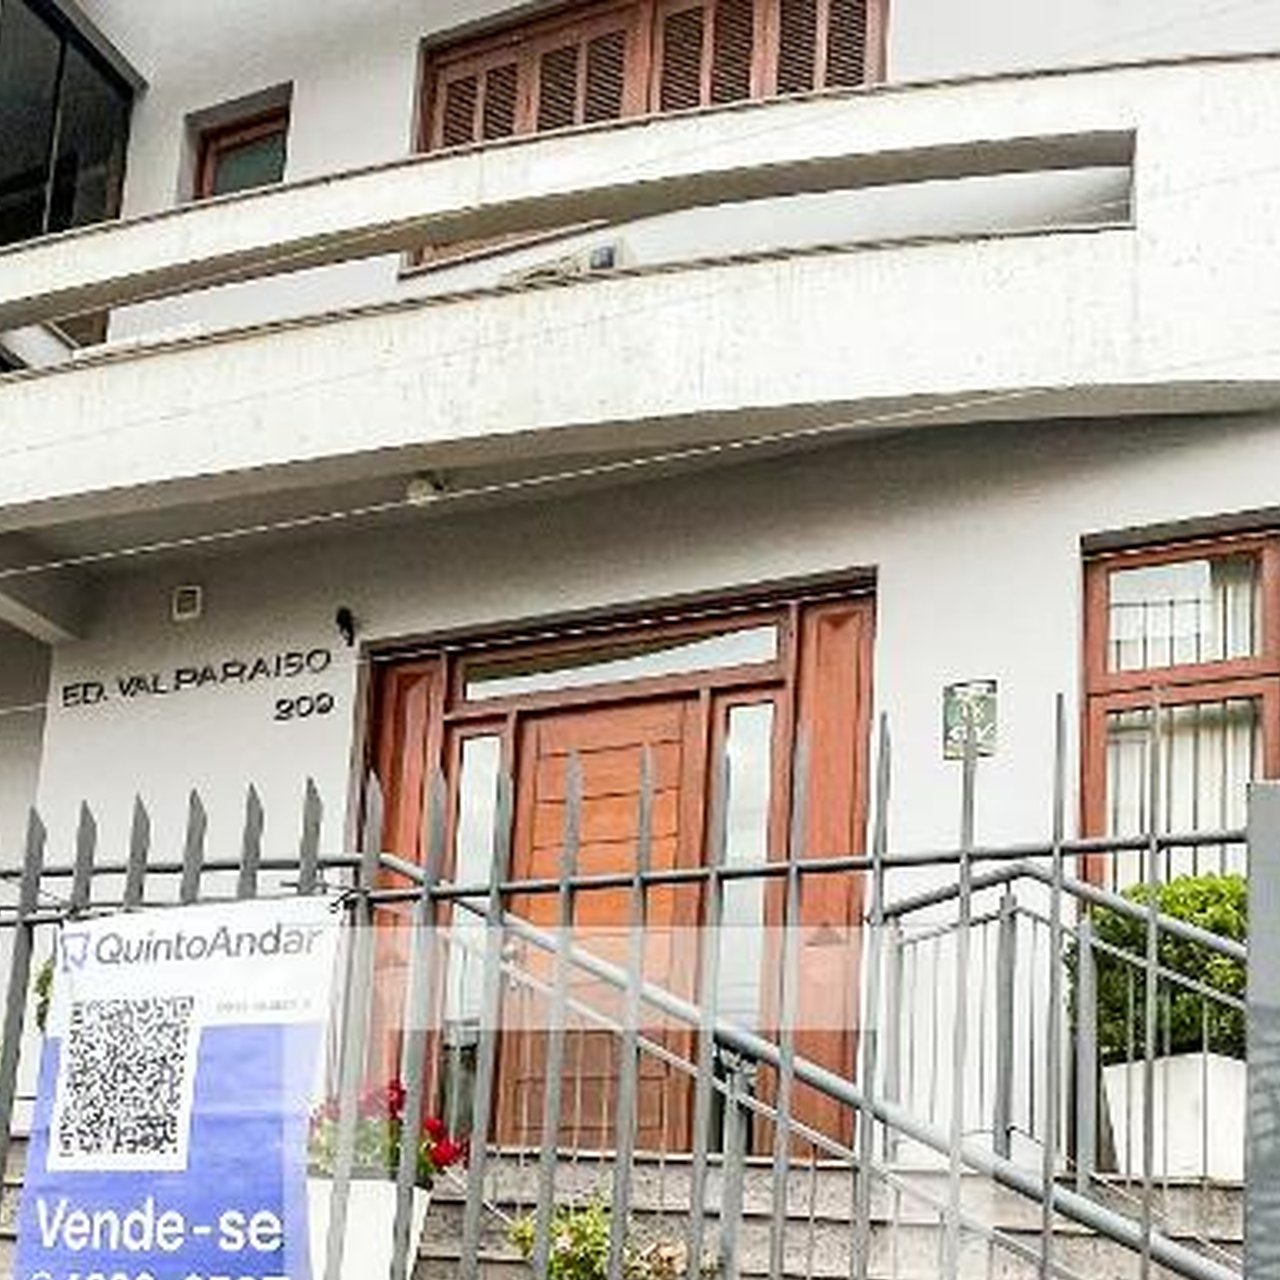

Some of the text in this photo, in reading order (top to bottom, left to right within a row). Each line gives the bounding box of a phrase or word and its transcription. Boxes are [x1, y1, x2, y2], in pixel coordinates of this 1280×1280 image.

[62, 682, 108, 707] ED.
[94, 922, 323, 966] QuintoAndar
[35, 1197, 283, 1253] Vende-se
